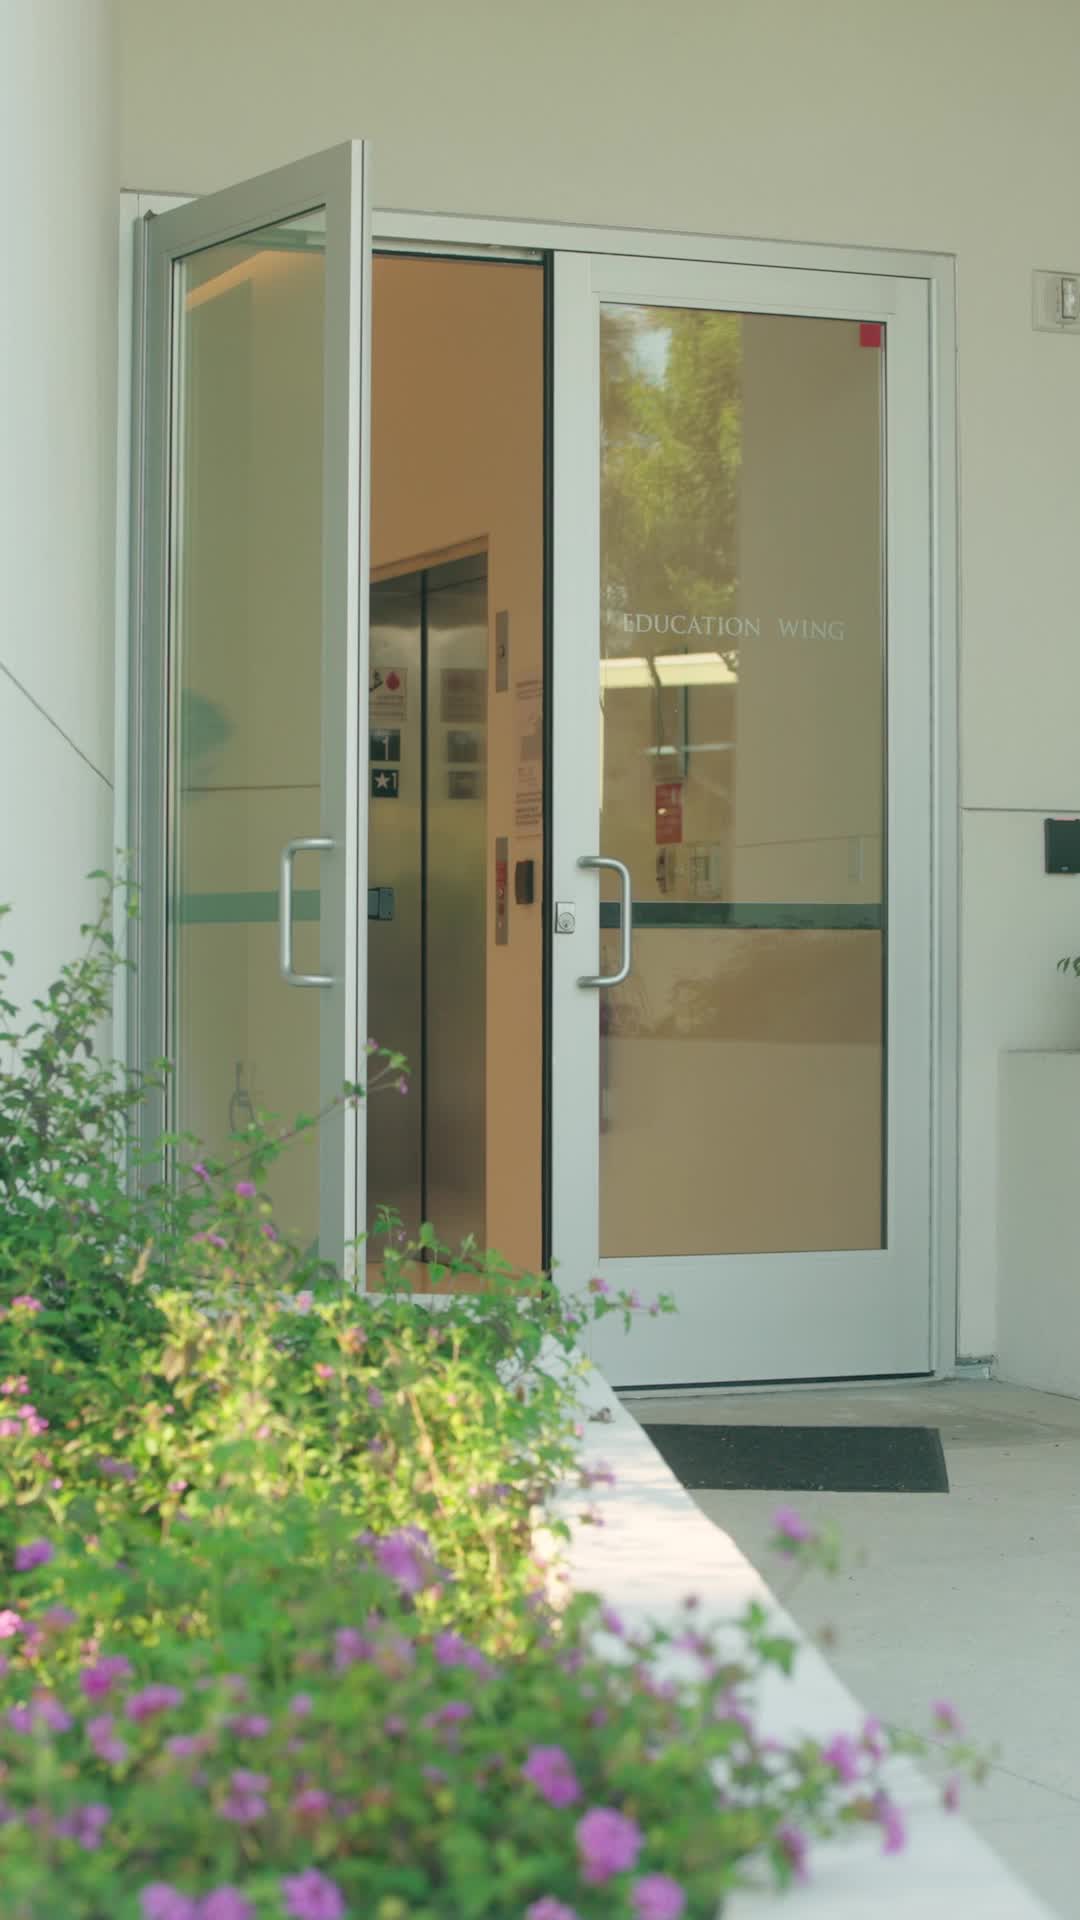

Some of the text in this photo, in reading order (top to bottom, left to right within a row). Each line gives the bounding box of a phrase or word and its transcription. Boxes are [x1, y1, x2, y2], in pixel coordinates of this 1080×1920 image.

[623, 613, 845, 641] EDUCATION WING
[382, 735, 389, 760] 1
